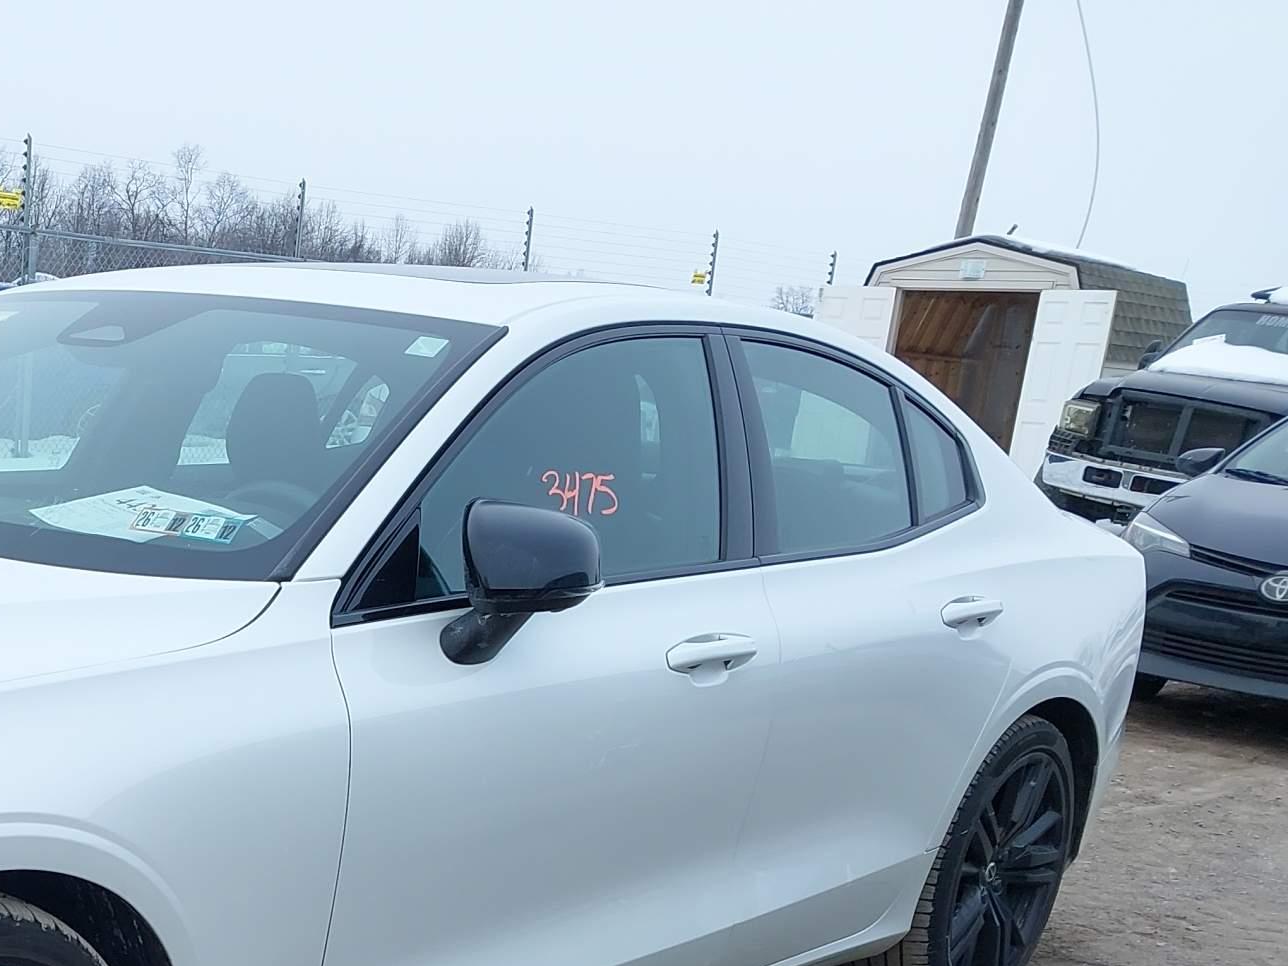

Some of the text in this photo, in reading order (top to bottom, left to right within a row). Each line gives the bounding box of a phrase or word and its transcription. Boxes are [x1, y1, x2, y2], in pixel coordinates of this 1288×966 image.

[541, 469, 619, 517] 3475
[136, 511, 155, 528] 26
[168, 518, 186, 533] 12
[185, 516, 202, 533] 26
[219, 524, 237, 540] 12
